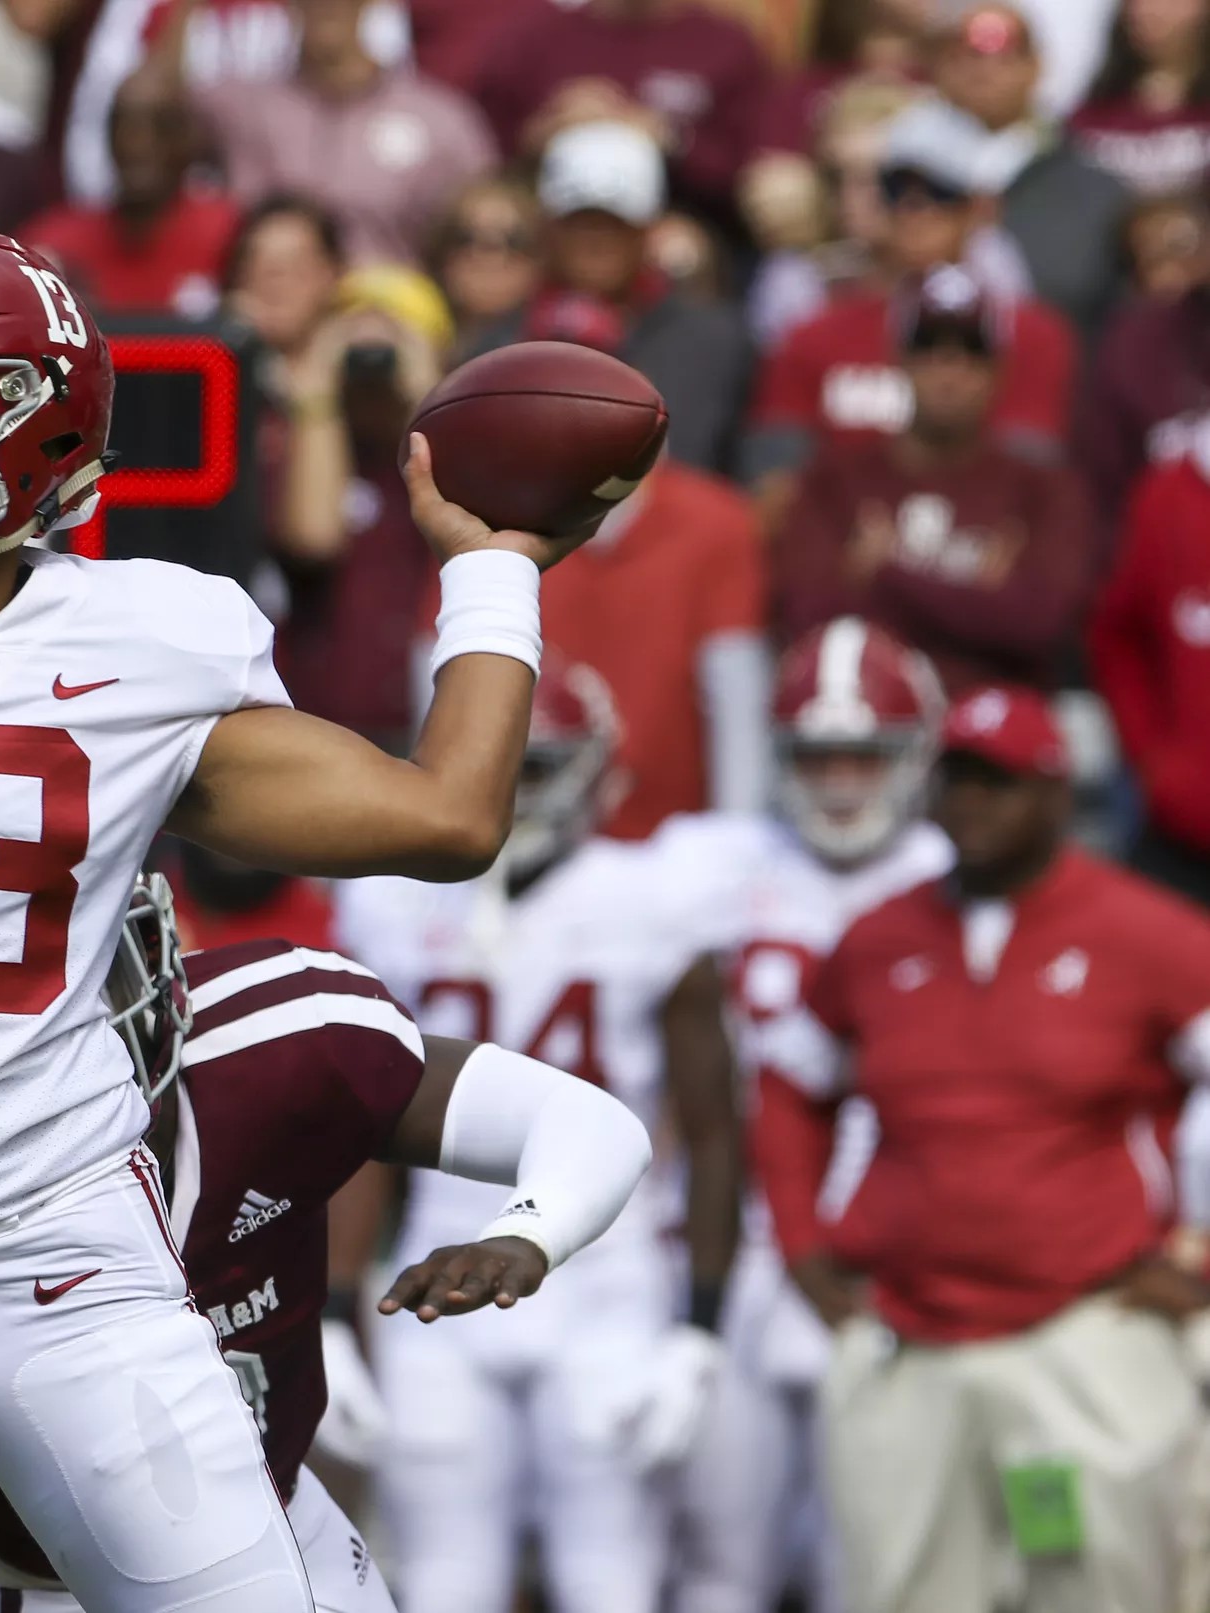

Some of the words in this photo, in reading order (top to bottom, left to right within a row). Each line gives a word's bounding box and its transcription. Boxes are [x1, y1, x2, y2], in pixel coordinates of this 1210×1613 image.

[18, 265, 88, 349] 13
[228, 1198, 292, 1243] adidas
[206, 1276, 280, 1338] A&M
